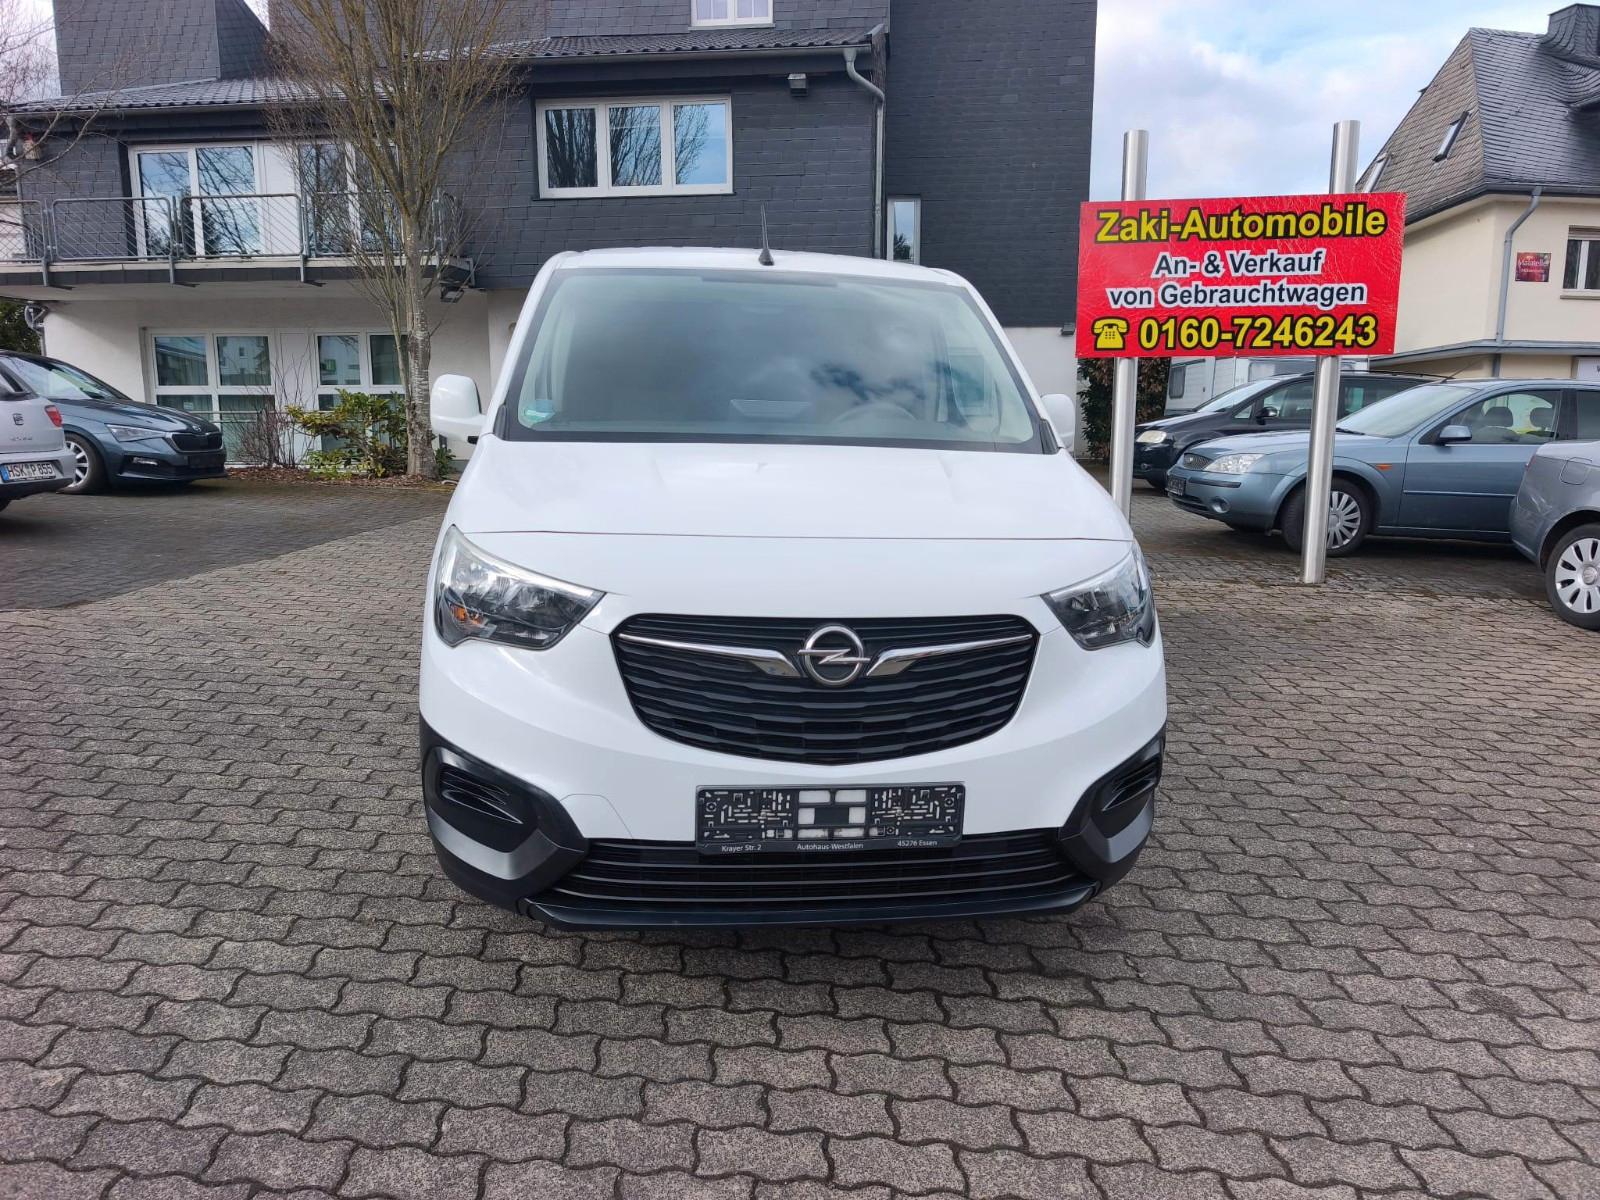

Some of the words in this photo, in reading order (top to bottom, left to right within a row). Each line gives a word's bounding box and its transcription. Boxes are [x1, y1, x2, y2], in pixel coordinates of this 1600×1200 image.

[1095, 202, 1388, 244] Zaki-Automobile
[1153, 252, 1199, 276] An-
[1204, 252, 1222, 275] &
[1229, 250, 1324, 274] Verkauf
[1108, 288, 1152, 307] von
[1160, 281, 1366, 308] Gebrauchtwagen
[1138, 314, 1379, 350] 0160-7246243
[6, 463, 27, 477] HSK
[721, 845, 744, 853] Krayer
[796, 842, 864, 850] Autohaus-Westfalen
[897, 839, 918, 847] 45276
[918, 839, 938, 847] Essen
